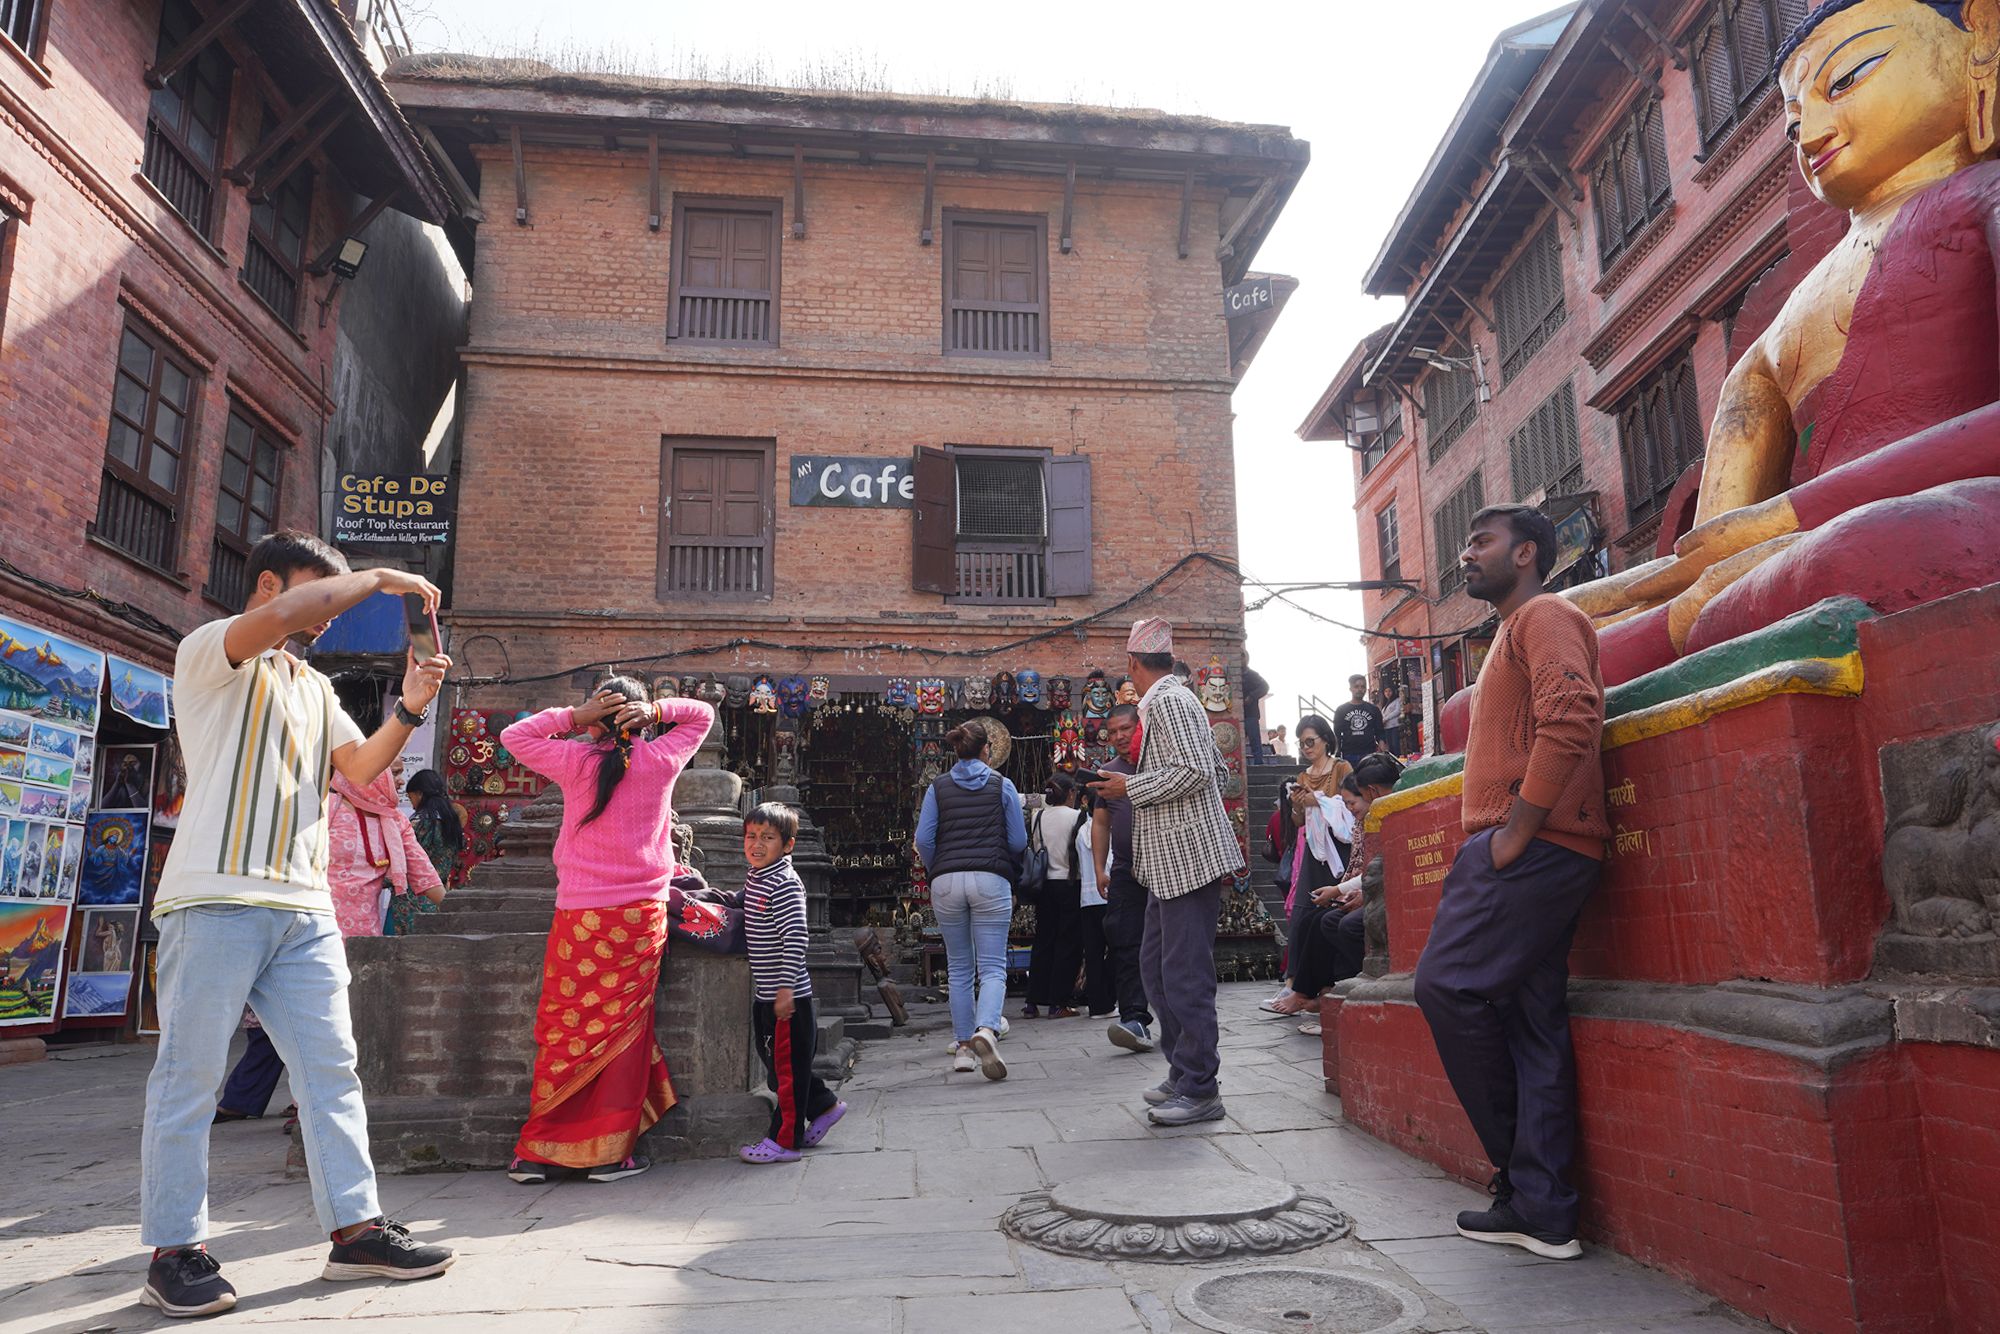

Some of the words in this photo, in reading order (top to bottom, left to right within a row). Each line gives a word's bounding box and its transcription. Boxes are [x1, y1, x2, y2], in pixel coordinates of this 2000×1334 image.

[1232, 286, 1268, 310] Cafe
[341, 474, 399, 494] Cafe
[797, 461, 812, 478] MY
[820, 462, 914, 503] Cafe
[343, 494, 433, 518] Stupa
[336, 516, 365, 529] Roof
[367, 518, 387, 532] Top
[388, 519, 449, 530] Restaurant
[1408, 835, 1428, 851] PLEASE
[1415, 852, 1434, 867] CLIMB
[1433, 850, 1443, 864] ON
[1412, 873, 1424, 886] THE
